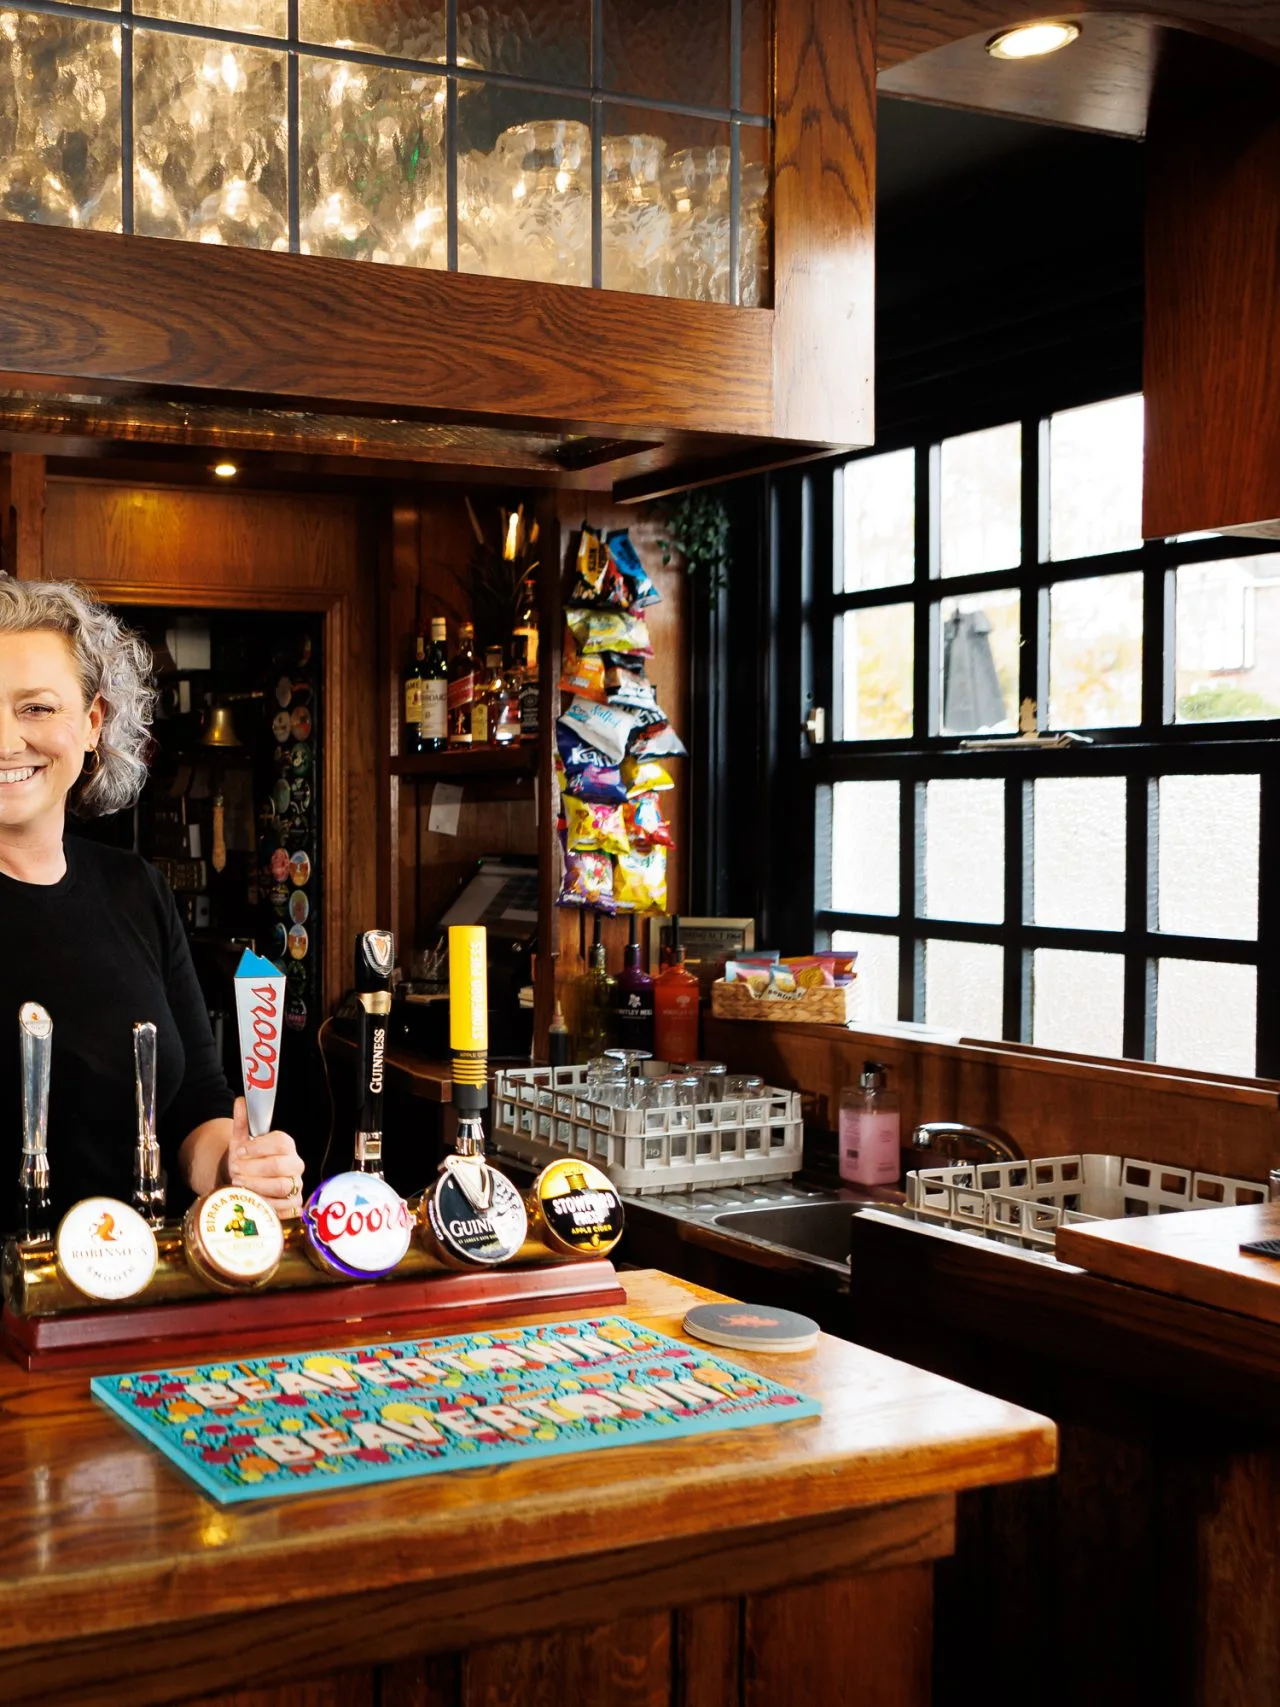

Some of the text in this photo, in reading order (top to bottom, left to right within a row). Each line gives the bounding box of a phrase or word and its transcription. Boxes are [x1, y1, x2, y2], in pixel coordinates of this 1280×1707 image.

[245, 983, 277, 1091] Coors
[369, 1028, 386, 1094] GUINNESS
[206, 1197, 228, 1233] BIRRA
[310, 1200, 417, 1243] Coors
[449, 1218, 495, 1238] GUINN
[184, 1334, 620, 1408] BEAVERTOWN
[254, 1380, 727, 1463] BEAVERTOWN
